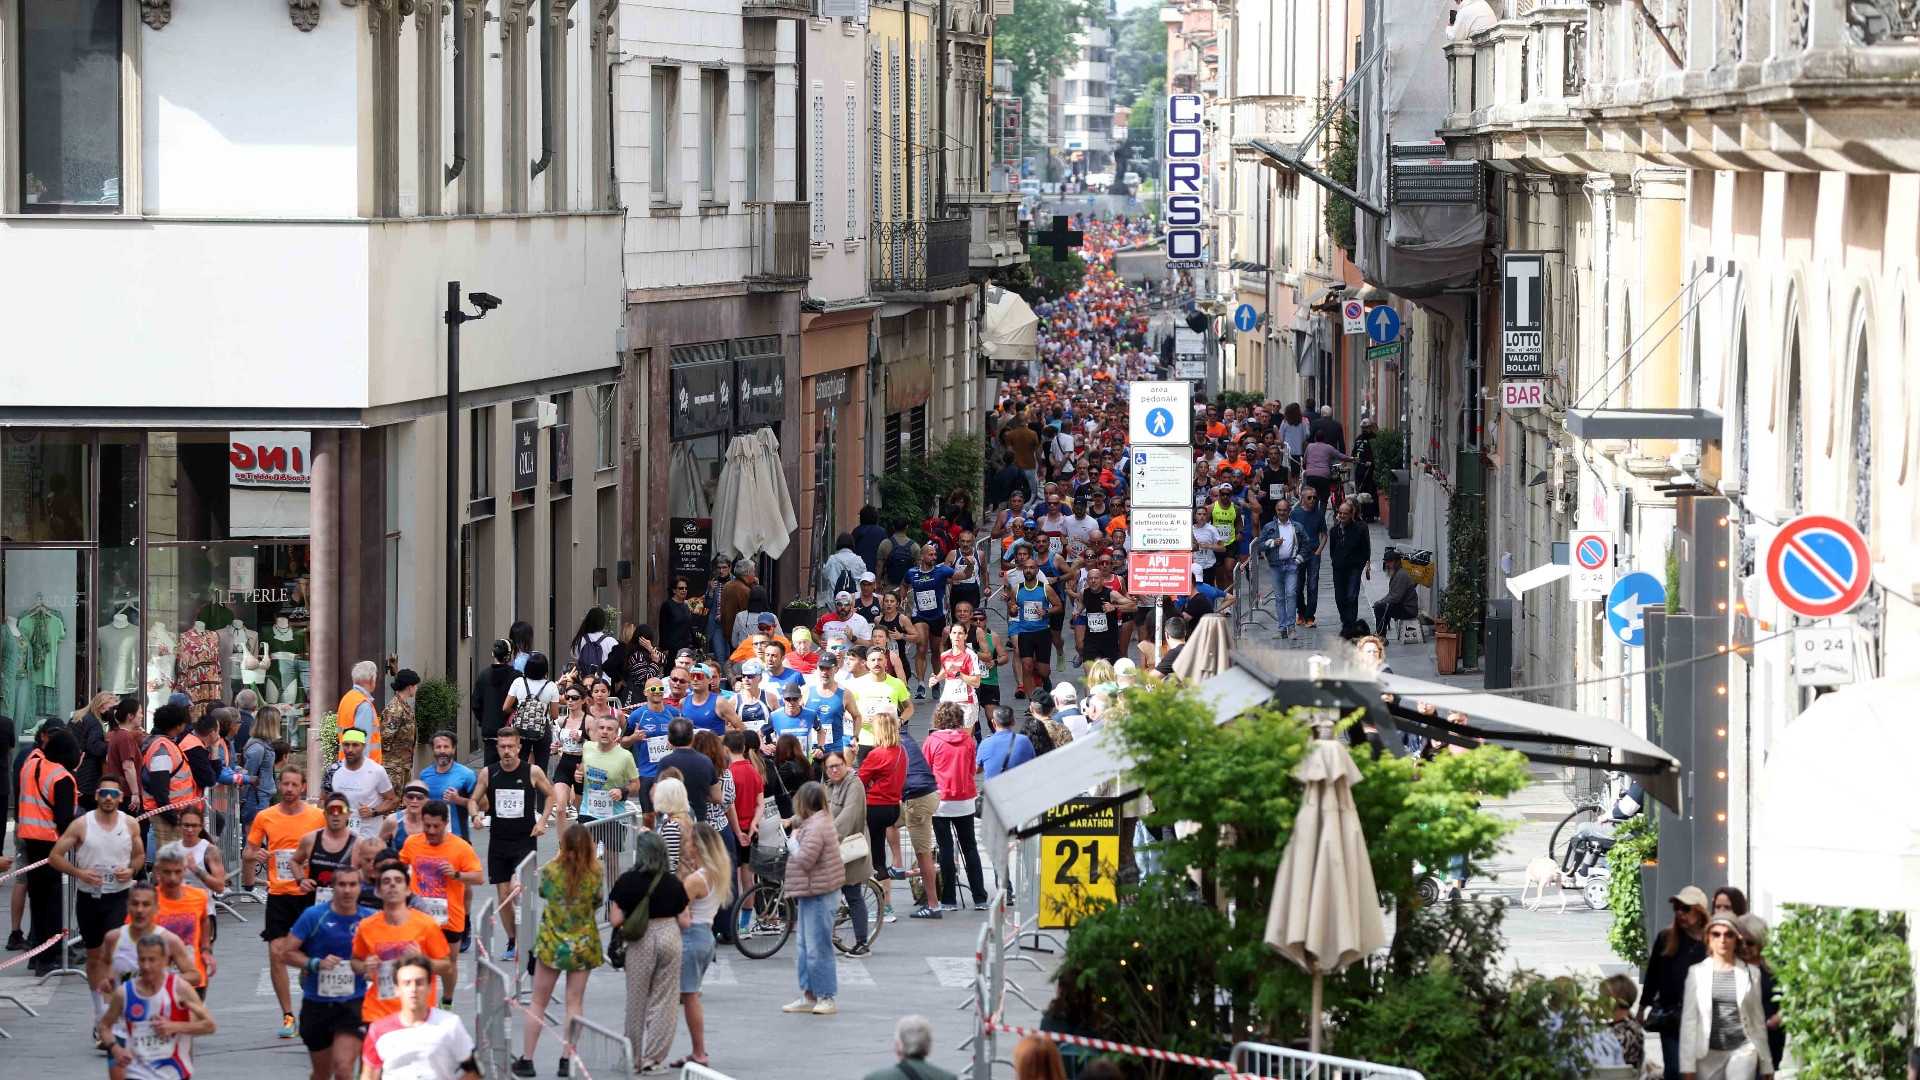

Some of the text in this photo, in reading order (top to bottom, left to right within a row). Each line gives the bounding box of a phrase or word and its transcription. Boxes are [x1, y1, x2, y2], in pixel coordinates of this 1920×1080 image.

[1168, 96, 1201, 259] CORSO
[1507, 261, 1540, 326] T
[1506, 332, 1541, 346] LOTTO
[1508, 354, 1537, 362] VALORI
[1506, 364, 1540, 372] BOLLATI
[1140, 395, 1178, 403] pedonale
[1506, 386, 1541, 404] BAR
[1149, 555, 1169, 567] APU
[244, 588, 289, 603] PERLE
[1823, 638, 1844, 650] 24
[503, 799, 517, 809] 824
[593, 799, 607, 809] 980
[1055, 839, 1099, 885] 21
